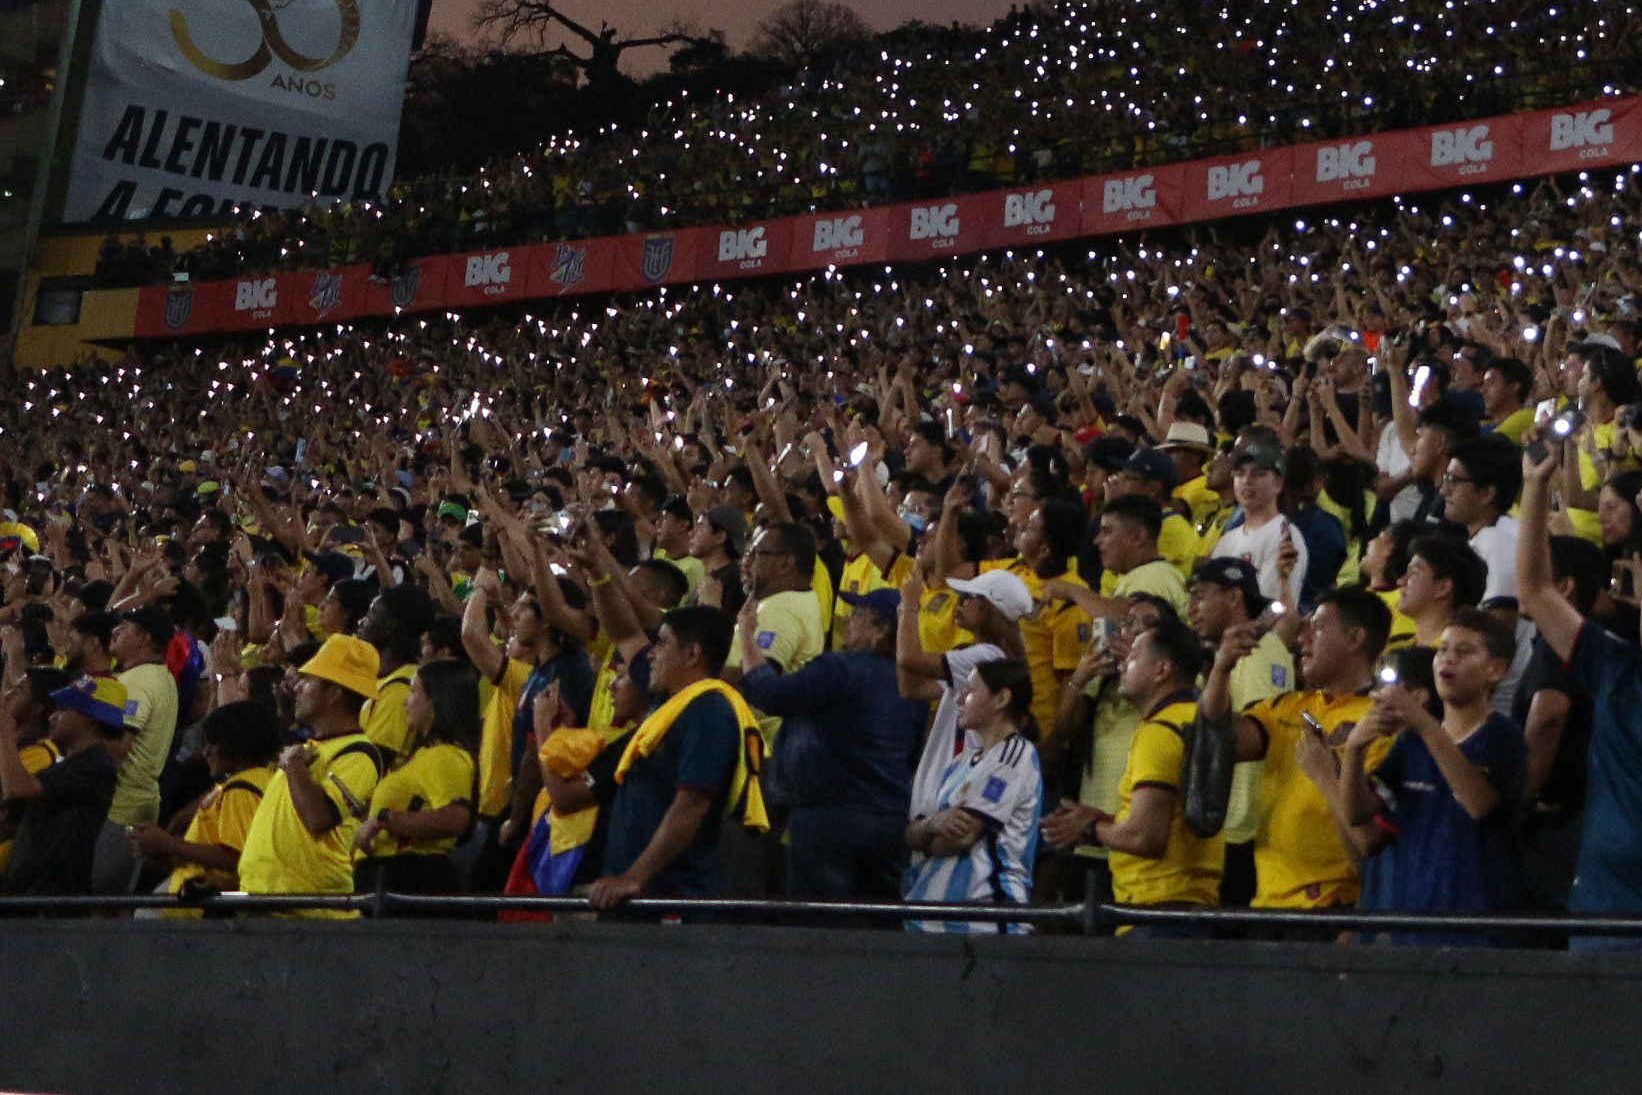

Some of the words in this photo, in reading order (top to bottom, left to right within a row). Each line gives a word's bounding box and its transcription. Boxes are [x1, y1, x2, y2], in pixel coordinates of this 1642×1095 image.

[1431, 125, 1493, 167] BIG
[1550, 109, 1614, 151] BIG
[102, 104, 390, 201] ALENTANDO
[1317, 141, 1375, 183] BIG
[1459, 162, 1487, 176] COLA
[1579, 146, 1610, 160] COLA
[1103, 175, 1155, 214] BIG
[1208, 161, 1263, 200] BIG
[1342, 178, 1370, 191] COLA
[1004, 190, 1056, 227] BIG
[1127, 209, 1151, 221] COLA
[1233, 196, 1259, 209] COLA
[813, 216, 864, 252] BIG
[909, 204, 960, 240] BIG
[1026, 224, 1051, 235] COLA
[718, 227, 767, 262] BIG
[465, 252, 511, 287] BIG
[235, 278, 277, 311] BIG
